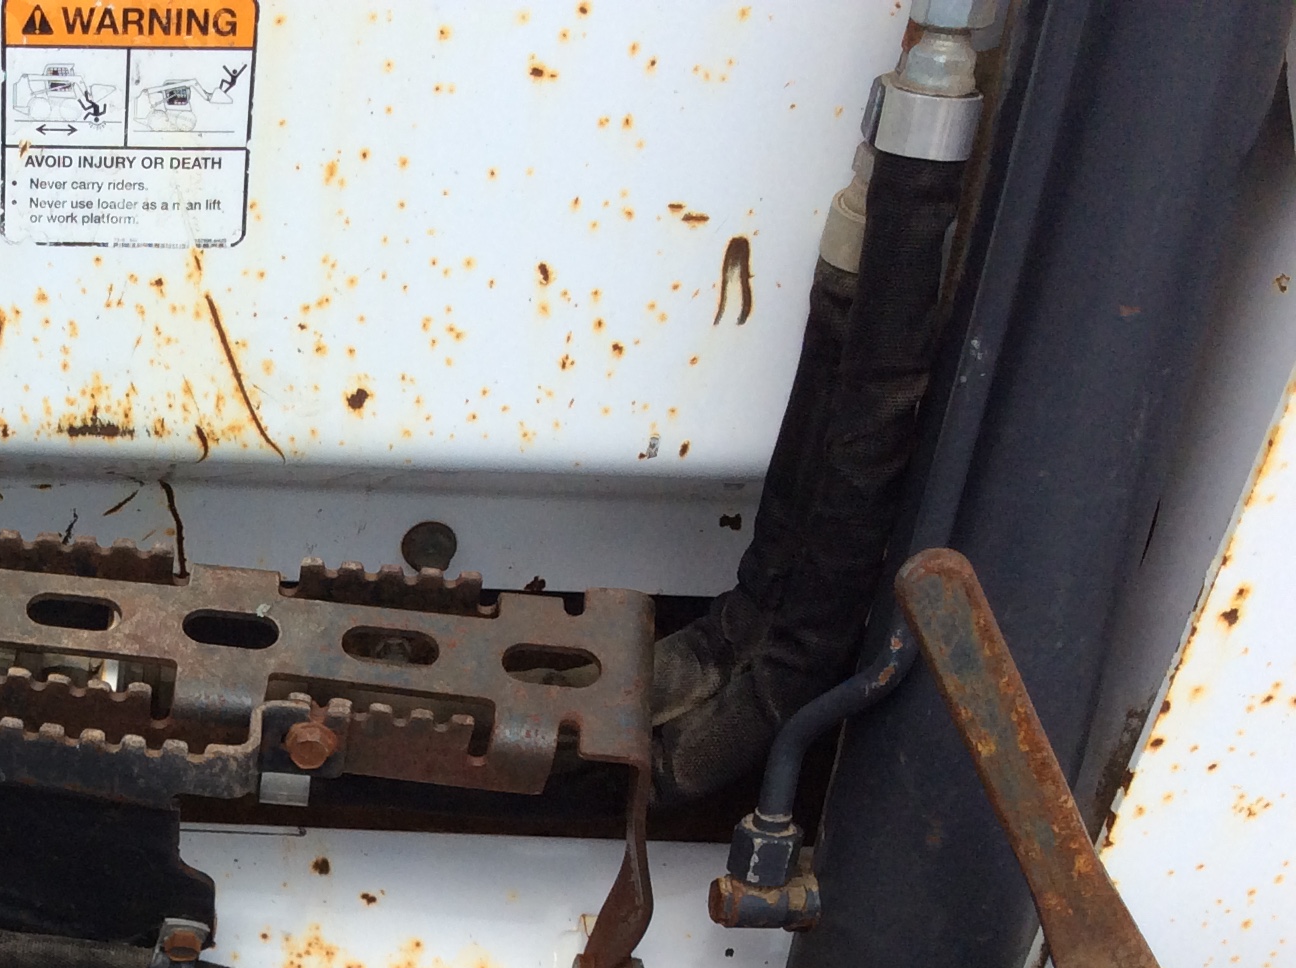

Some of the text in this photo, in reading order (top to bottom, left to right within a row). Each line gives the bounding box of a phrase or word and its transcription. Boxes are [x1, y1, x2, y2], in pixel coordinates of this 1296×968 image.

[62, 6, 238, 37] WARNING
[24, 155, 223, 170] AVOID INJURY OR DEATH
[29, 178, 67, 190] Never
[71, 180, 104, 192] carry
[29, 198, 67, 210] Never
[70, 200, 94, 211] use
[97, 199, 139, 211] loader
[141, 201, 157, 211] as
[160, 201, 169, 211] a
[205, 200, 222, 212] lift
[29, 215, 43, 224] or
[46, 213, 78, 224] work
